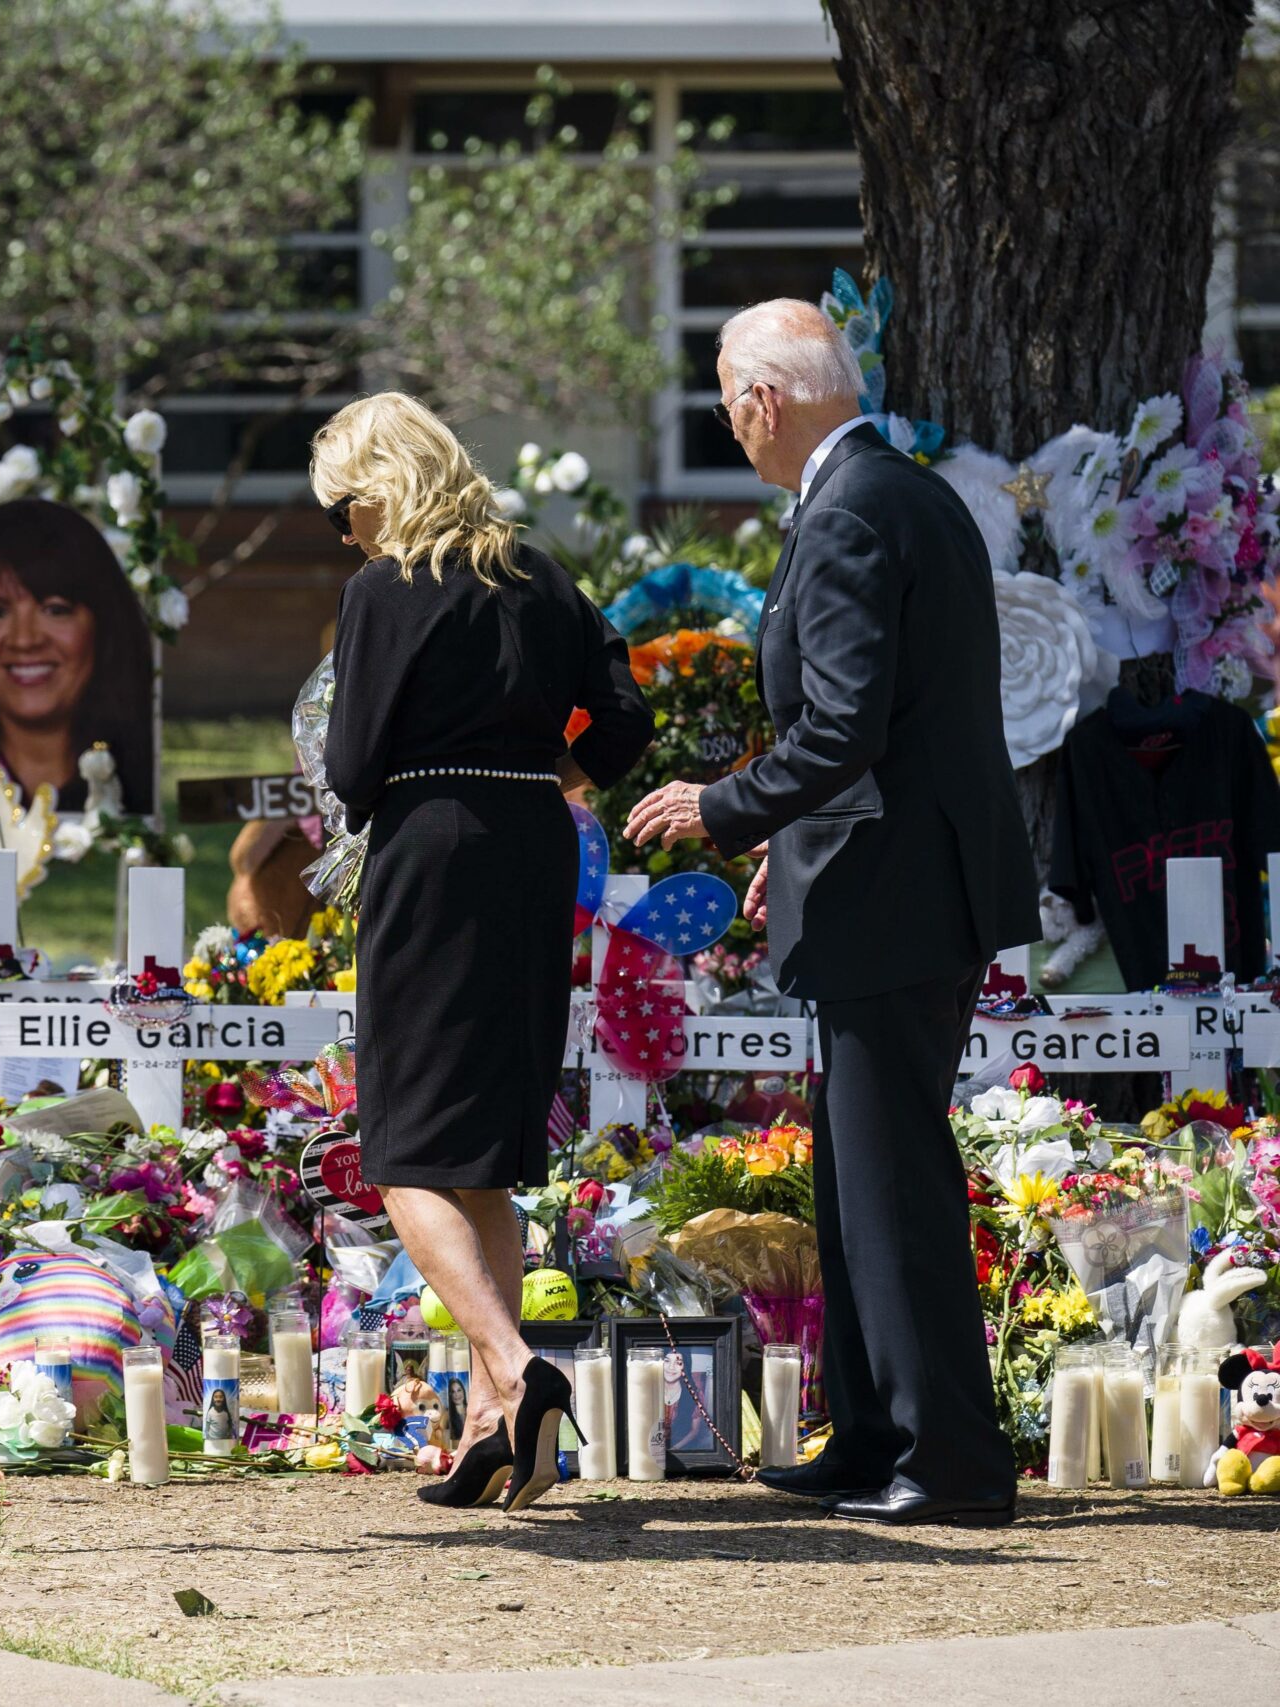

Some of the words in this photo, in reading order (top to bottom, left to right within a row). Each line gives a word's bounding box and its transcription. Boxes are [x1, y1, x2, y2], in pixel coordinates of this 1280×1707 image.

[237, 777, 322, 820] JES
[20, 1015, 111, 1047] Ellie
[136, 1014, 285, 1048] Garcia
[666, 1029, 793, 1058] orres
[1011, 1029, 1160, 1060] Garcia
[132, 1060, 179, 1069] 5-24-22
[545, 1285, 568, 1297] NCAA
